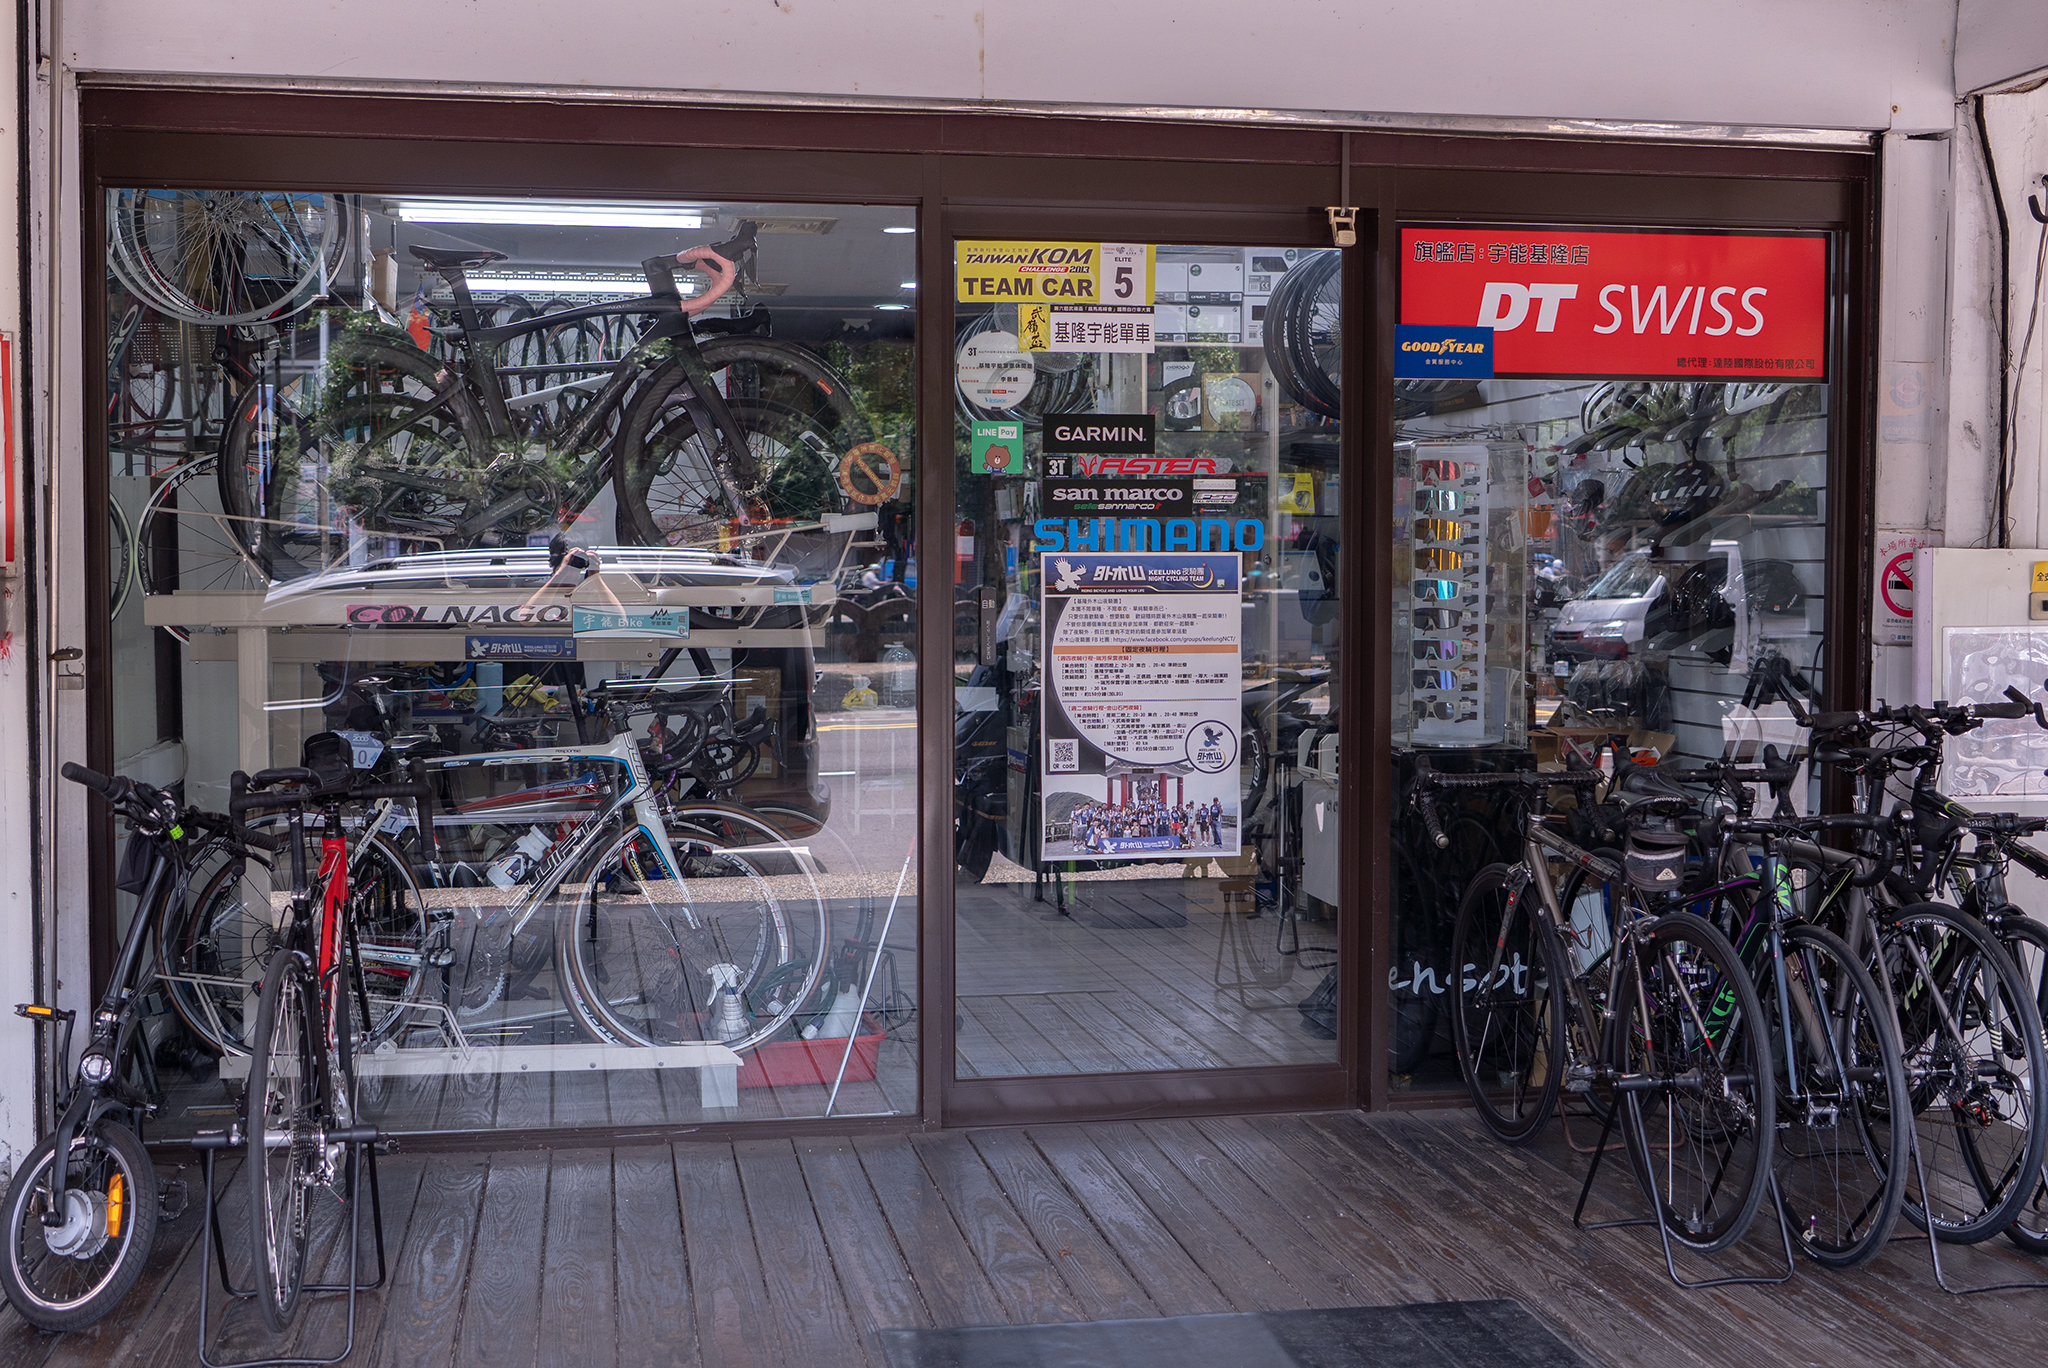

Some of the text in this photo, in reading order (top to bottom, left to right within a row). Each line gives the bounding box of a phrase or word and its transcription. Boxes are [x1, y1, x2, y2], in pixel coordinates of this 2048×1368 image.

[966, 248, 1093, 264] TAIWAN KOM
[963, 278, 1094, 297] TEAM CAR
[1114, 266, 1134, 298] 5
[1476, 282, 1768, 336] DT SWISS
[1054, 322, 1150, 344] 基隆宇能單車
[968, 348, 978, 356] 3T
[977, 428, 1016, 438] LINE Pay
[1054, 426, 1144, 442] GARMIN
[1048, 460, 1066, 474] 3T
[1052, 487, 1183, 500] san marco
[1034, 518, 1264, 552] SHIMANO
[350, 605, 569, 623] COLNAGO
[582, 614, 643, 630] 宇能 Bike
